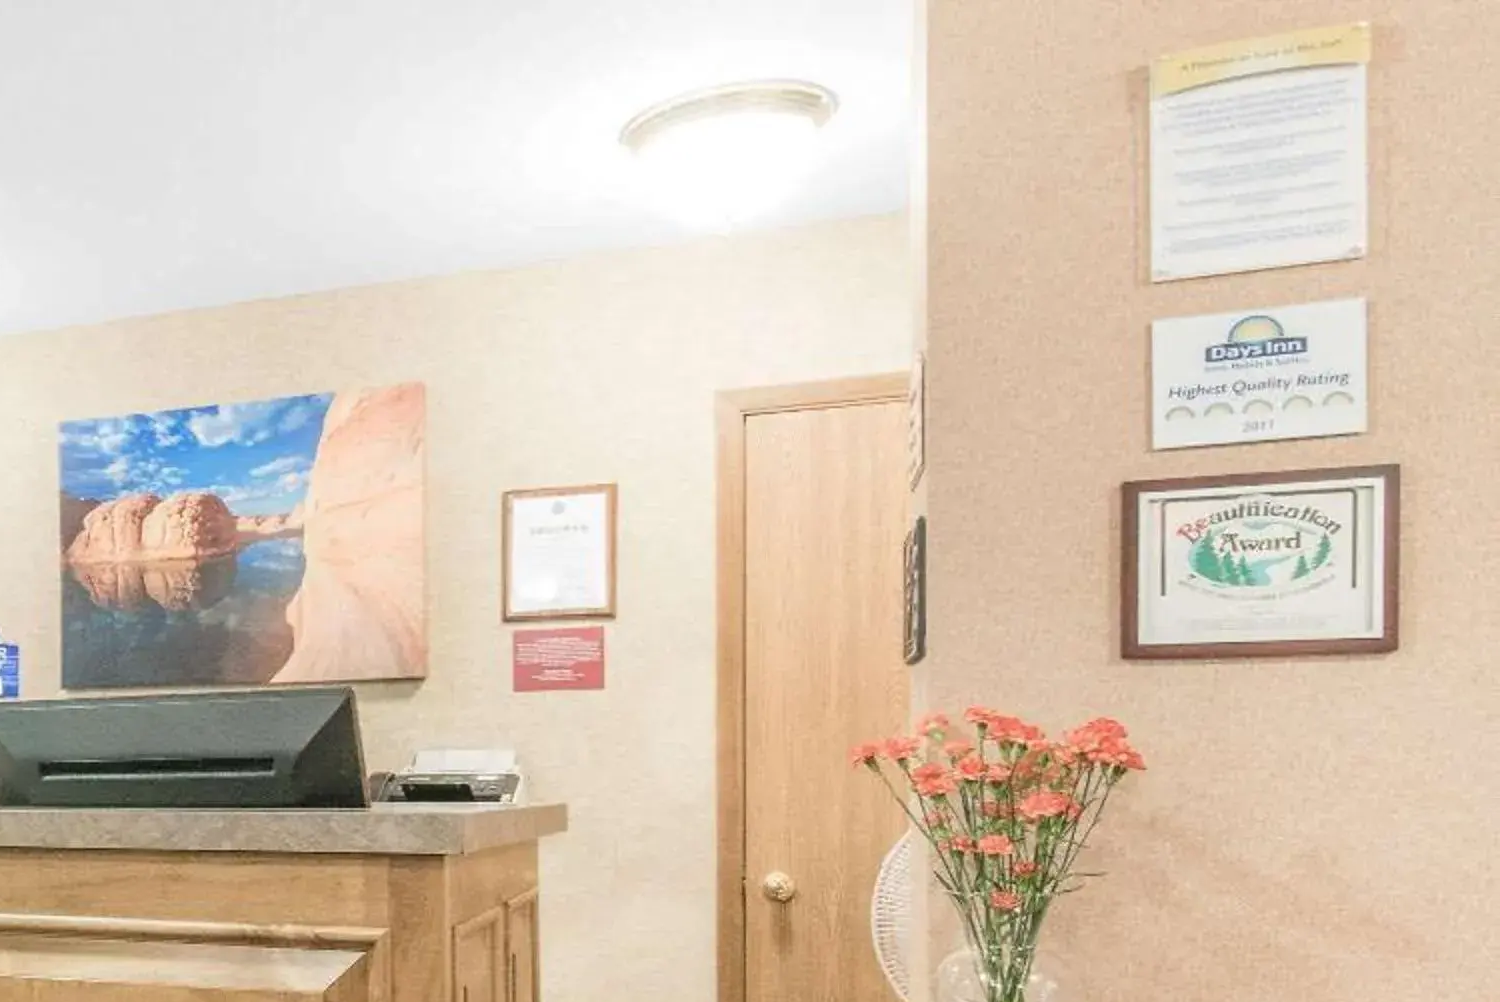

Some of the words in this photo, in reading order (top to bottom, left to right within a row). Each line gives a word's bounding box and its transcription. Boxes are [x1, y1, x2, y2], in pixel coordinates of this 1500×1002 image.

[1210, 344, 1262, 360] Days
[1266, 340, 1303, 354] Inn
[1168, 384, 1229, 400] Highest
[1231, 376, 1291, 396] Quality
[1296, 370, 1351, 386] Rating
[1176, 501, 1342, 545] Beautification
[1219, 531, 1301, 553] Award
